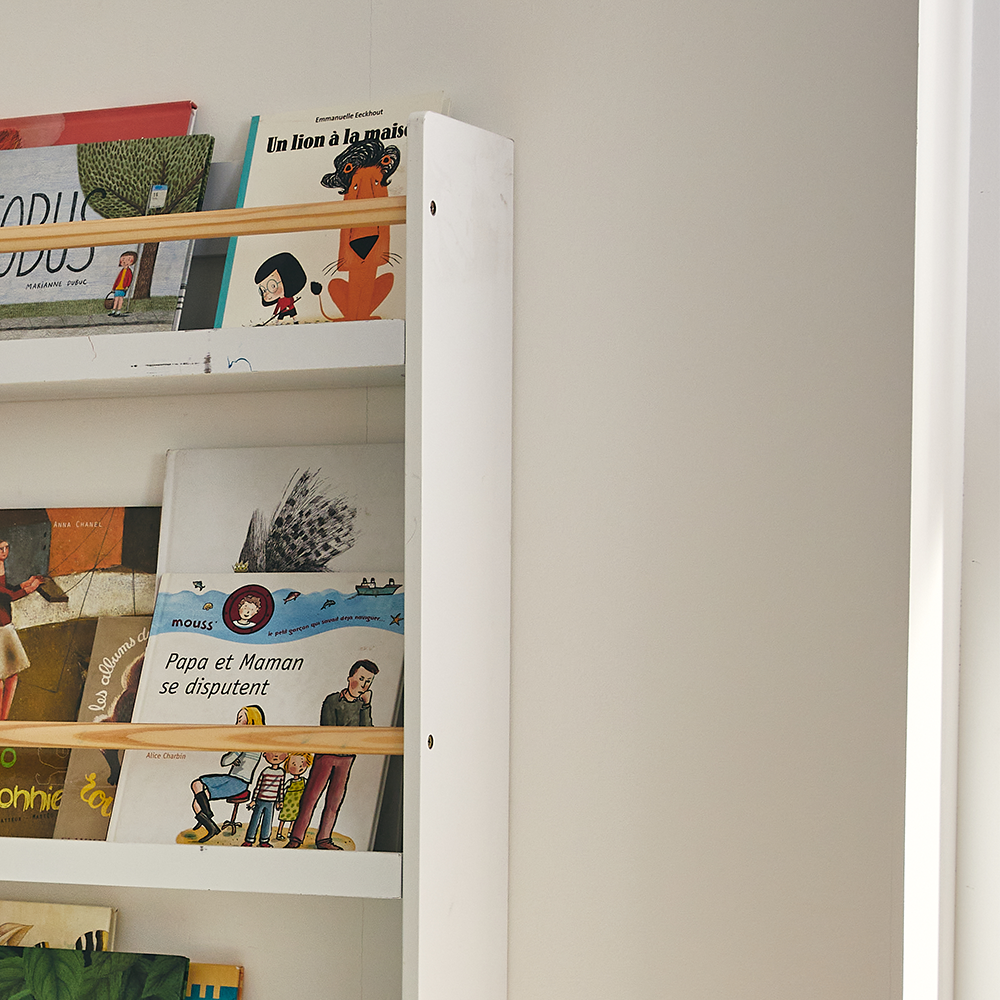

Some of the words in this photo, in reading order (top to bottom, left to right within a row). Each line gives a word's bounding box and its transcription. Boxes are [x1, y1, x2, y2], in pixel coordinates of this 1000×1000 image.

[315, 112, 353, 123] Emmanuelle
[354, 109, 384, 119] Eeckhout
[266, 136, 288, 153] Un
[290, 133, 325, 151] lion
[328, 130, 340, 147] à
[342, 128, 360, 145] la
[25, 281, 62, 290] MARIANNE
[66, 279, 87, 287] DUBUC
[53, 520, 72, 528] ANNA
[288, 624, 310, 635] garçon
[321, 616, 339, 625] savait
[165, 652, 209, 674] Papa
[215, 654, 234, 670] et
[239, 653, 304, 671] Maman
[88, 690, 108, 711] les
[98, 637, 136, 686] albums
[159, 681, 179, 694] se
[185, 677, 270, 699] disputent
[163, 752, 186, 760] Charbin
